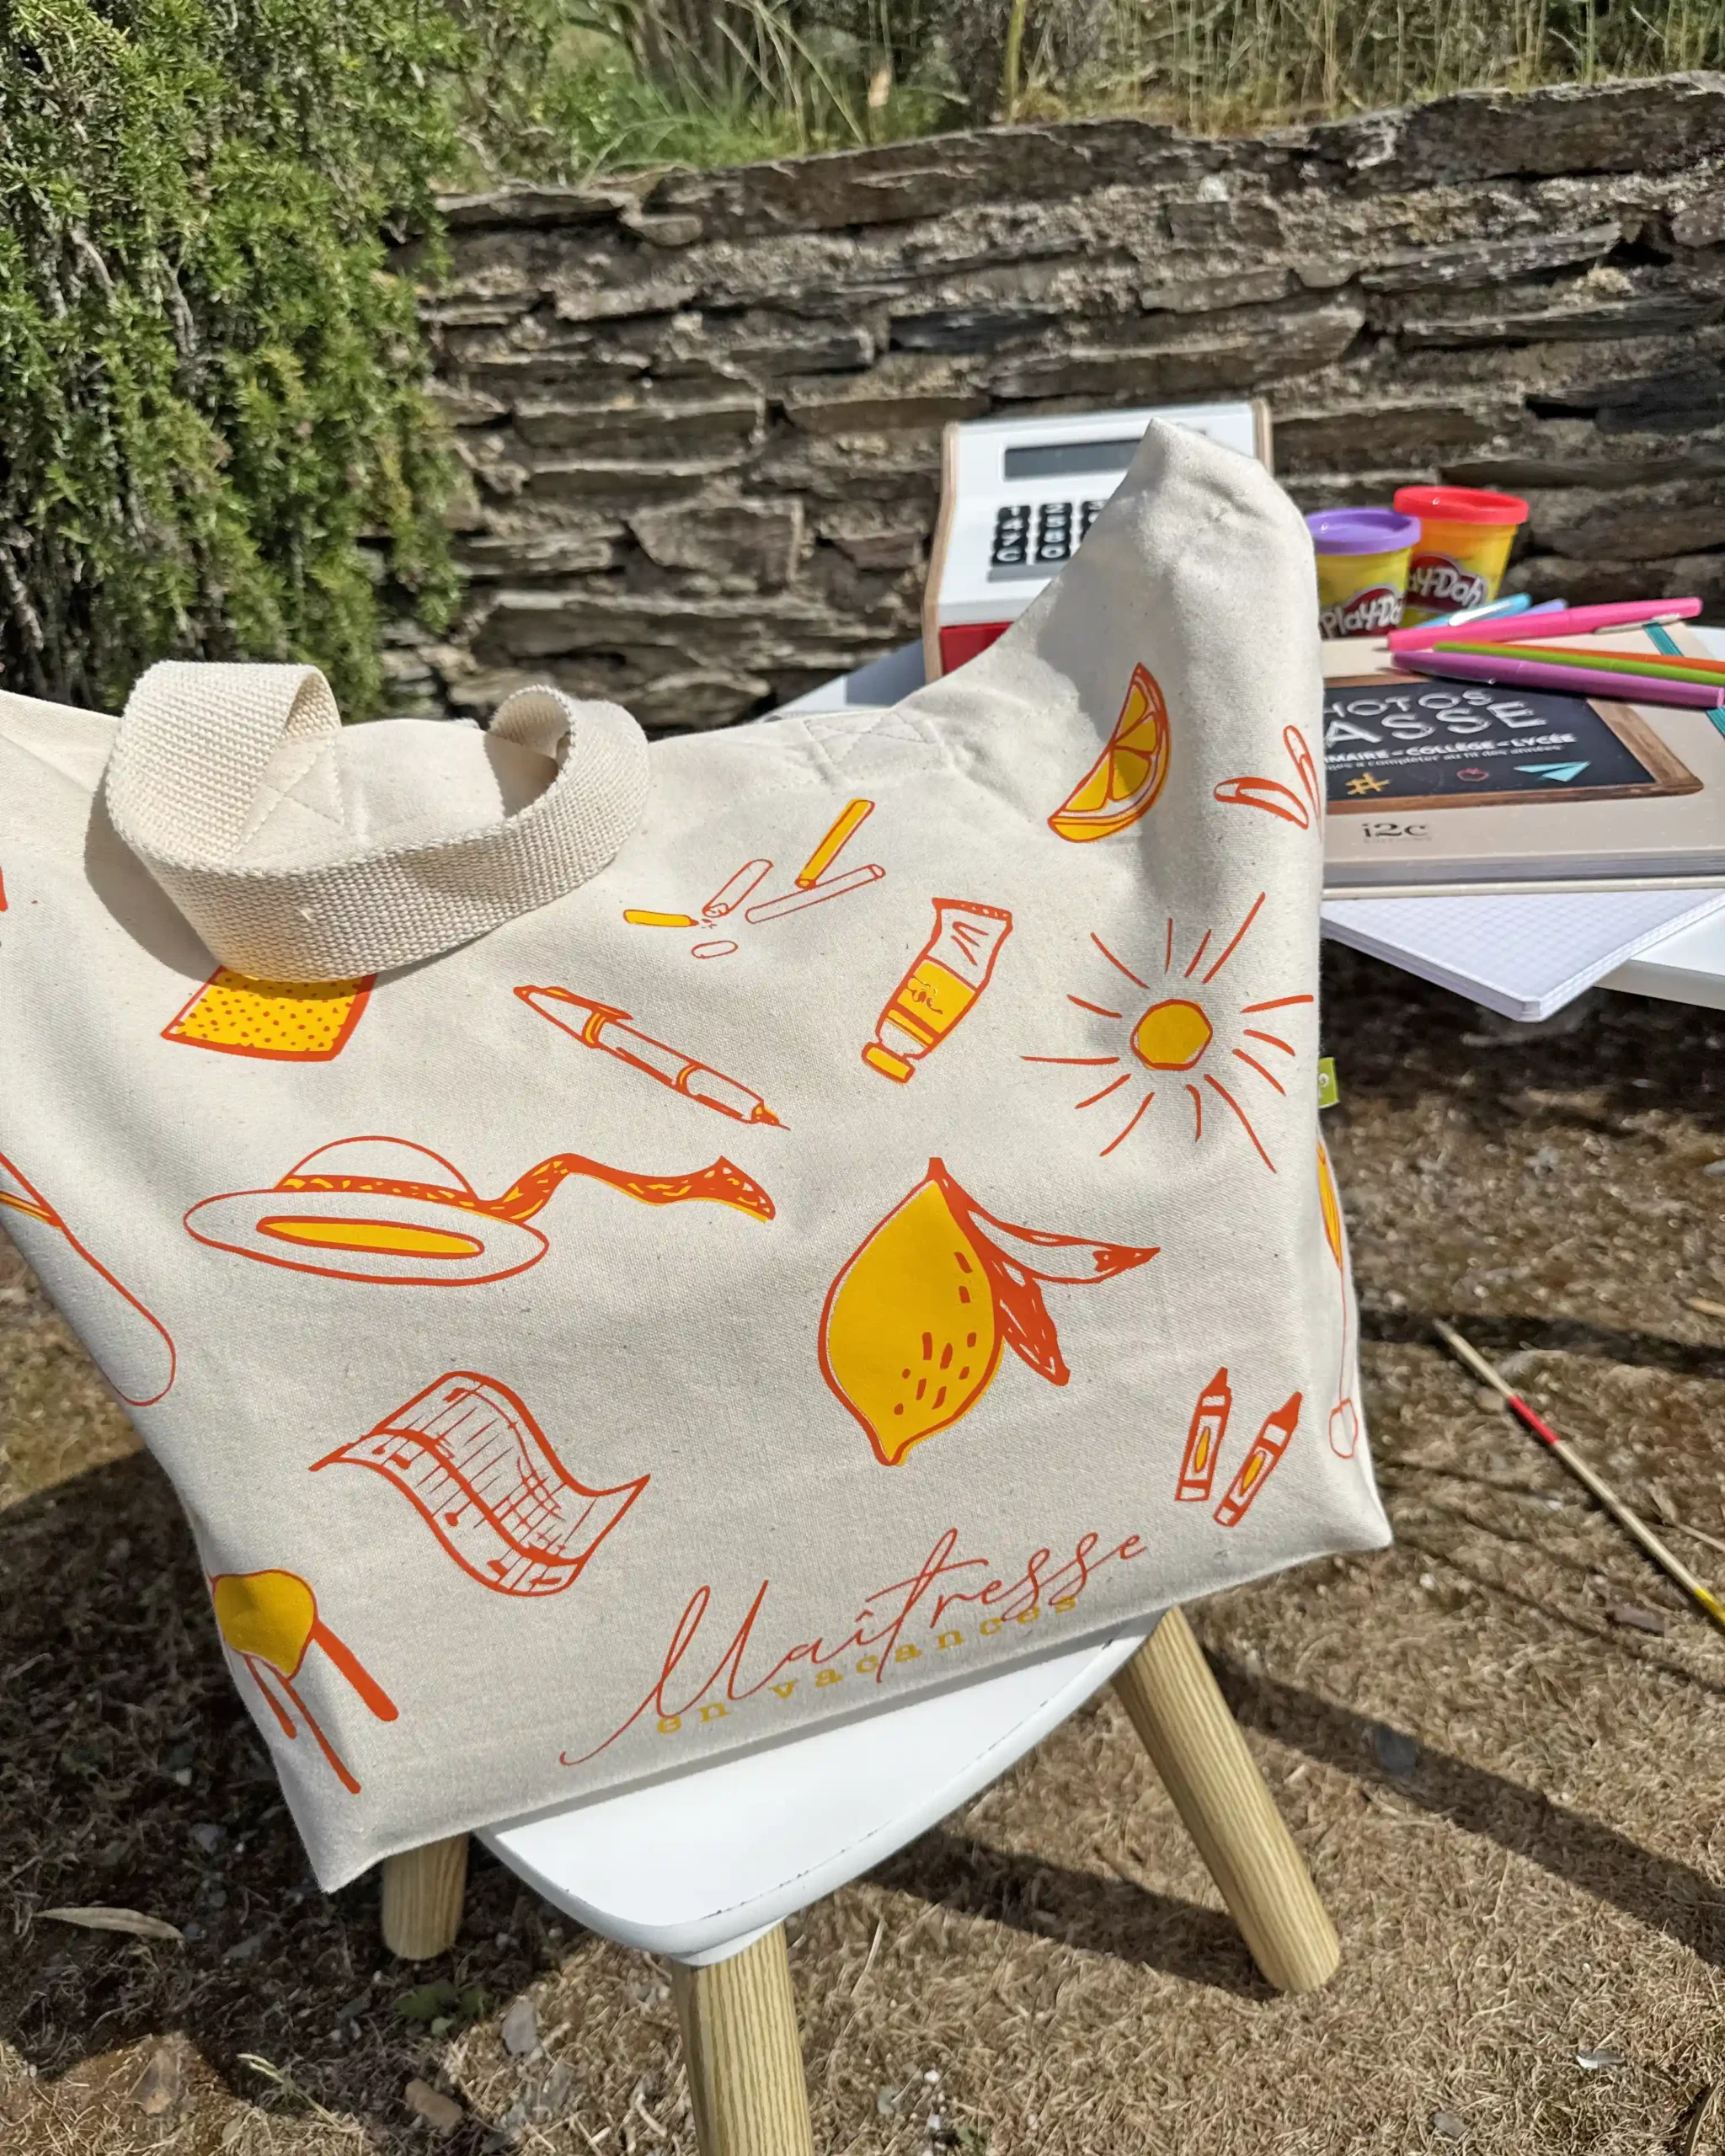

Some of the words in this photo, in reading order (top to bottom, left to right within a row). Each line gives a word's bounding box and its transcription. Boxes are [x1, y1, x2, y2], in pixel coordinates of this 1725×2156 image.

[1045, 514, 1066, 528] 5
[1323, 700, 1548, 749] ASSE
[558, 1527, 1148, 1767] Maîtresse
[656, 1701, 732, 1735] en
[767, 1594, 1077, 1700] vacances
